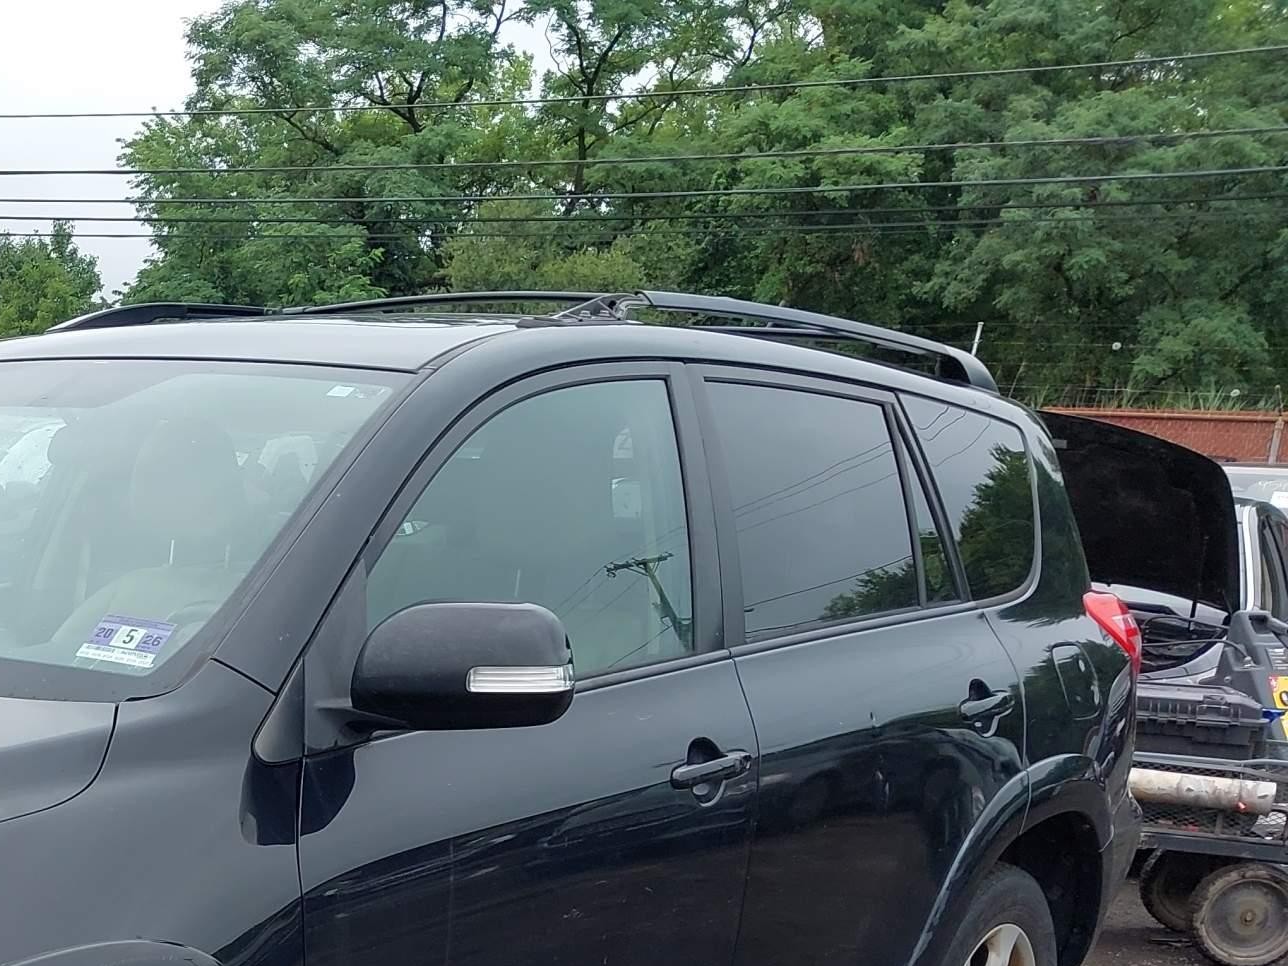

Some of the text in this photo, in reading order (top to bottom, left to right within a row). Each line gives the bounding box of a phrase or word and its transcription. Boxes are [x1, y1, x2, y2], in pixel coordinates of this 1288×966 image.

[95, 627, 115, 639] 20
[122, 628, 139, 645] 5
[142, 635, 164, 647] 26
